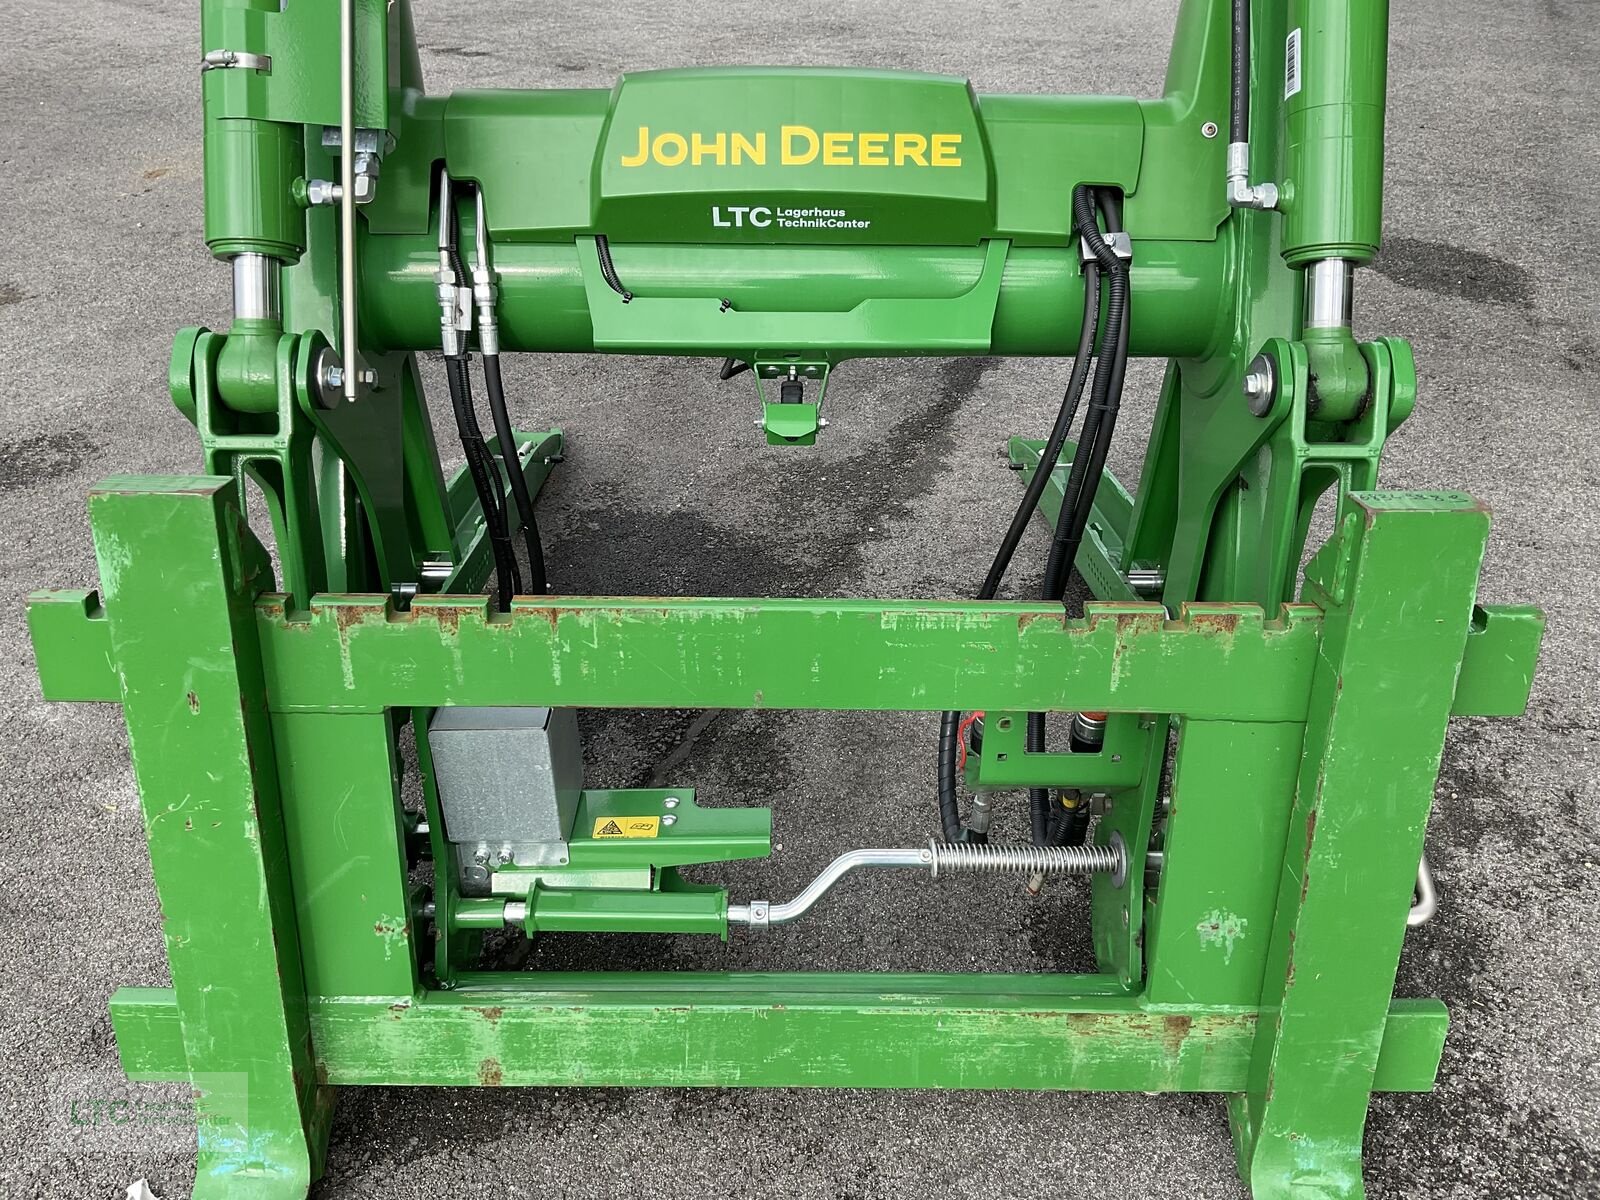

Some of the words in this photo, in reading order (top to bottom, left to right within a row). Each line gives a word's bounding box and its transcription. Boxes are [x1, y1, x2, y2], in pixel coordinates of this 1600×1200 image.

[621, 126, 766, 167] JOHN
[781, 125, 962, 167] DEERE
[712, 206, 772, 228] LTC
[776, 207, 846, 219] Lagerhaus
[777, 218, 871, 229] TechnikCenter
